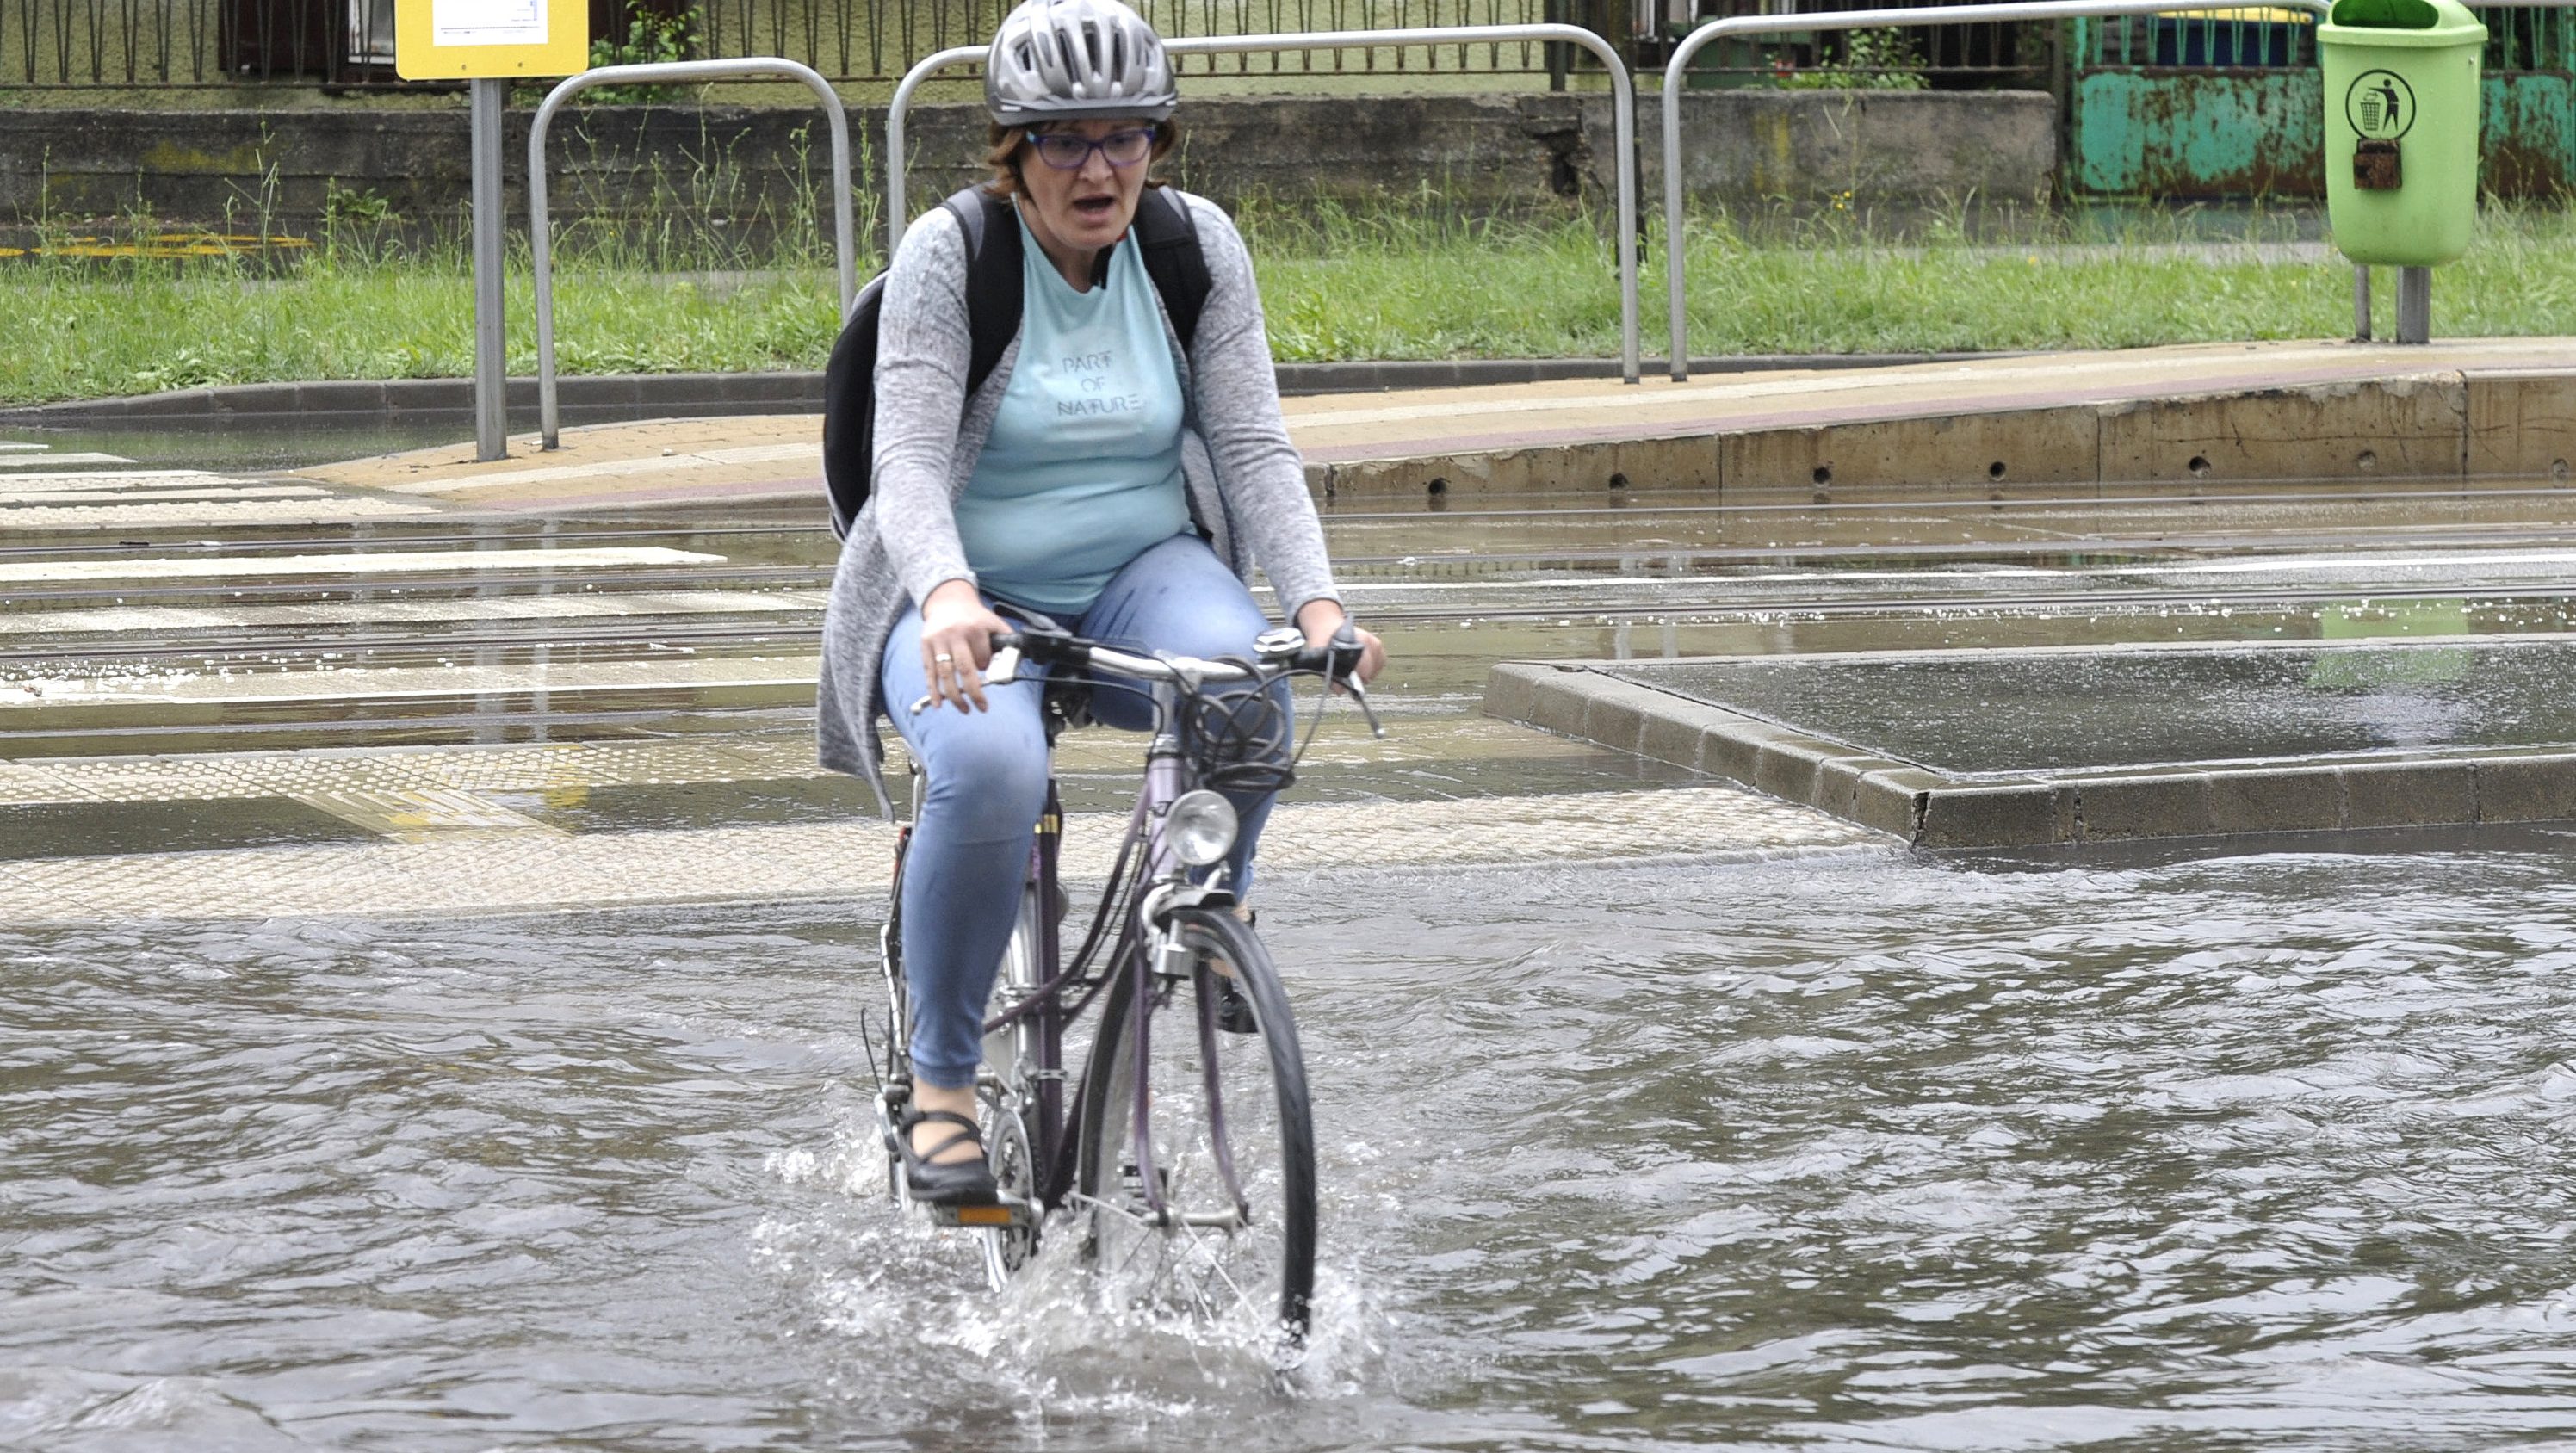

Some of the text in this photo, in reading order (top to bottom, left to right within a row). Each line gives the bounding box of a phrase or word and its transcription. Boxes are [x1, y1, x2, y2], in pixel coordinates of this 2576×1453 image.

[1062, 350, 1112, 372] PART
[1081, 377, 1105, 392] OF
[1057, 393, 1142, 416] NATURE
